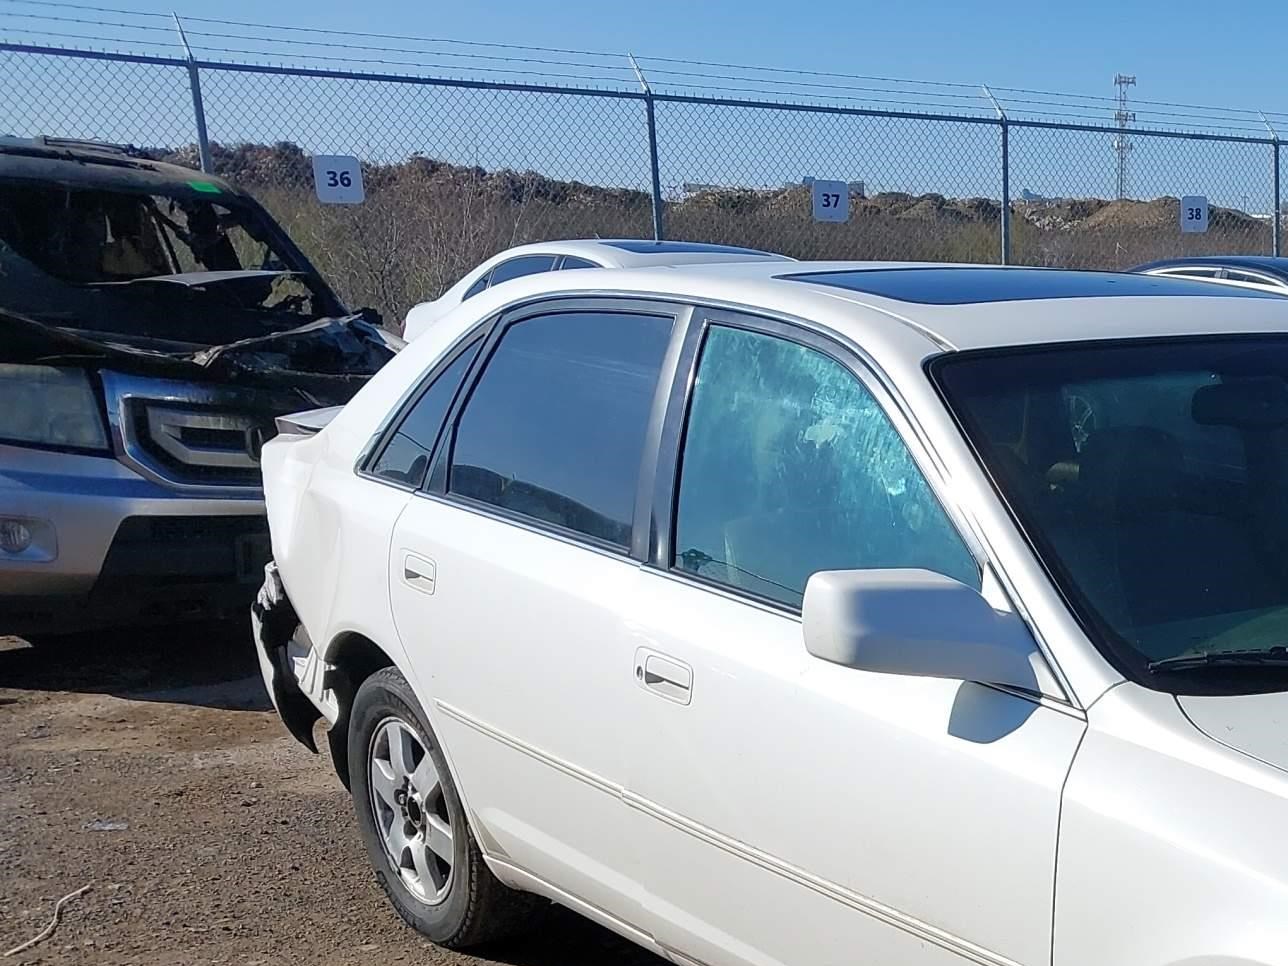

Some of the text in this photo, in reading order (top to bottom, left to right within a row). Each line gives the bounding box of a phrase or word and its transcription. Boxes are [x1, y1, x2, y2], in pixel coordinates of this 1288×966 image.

[327, 171, 352, 188] 36
[821, 194, 840, 209] 37
[1187, 207, 1202, 220] 38
